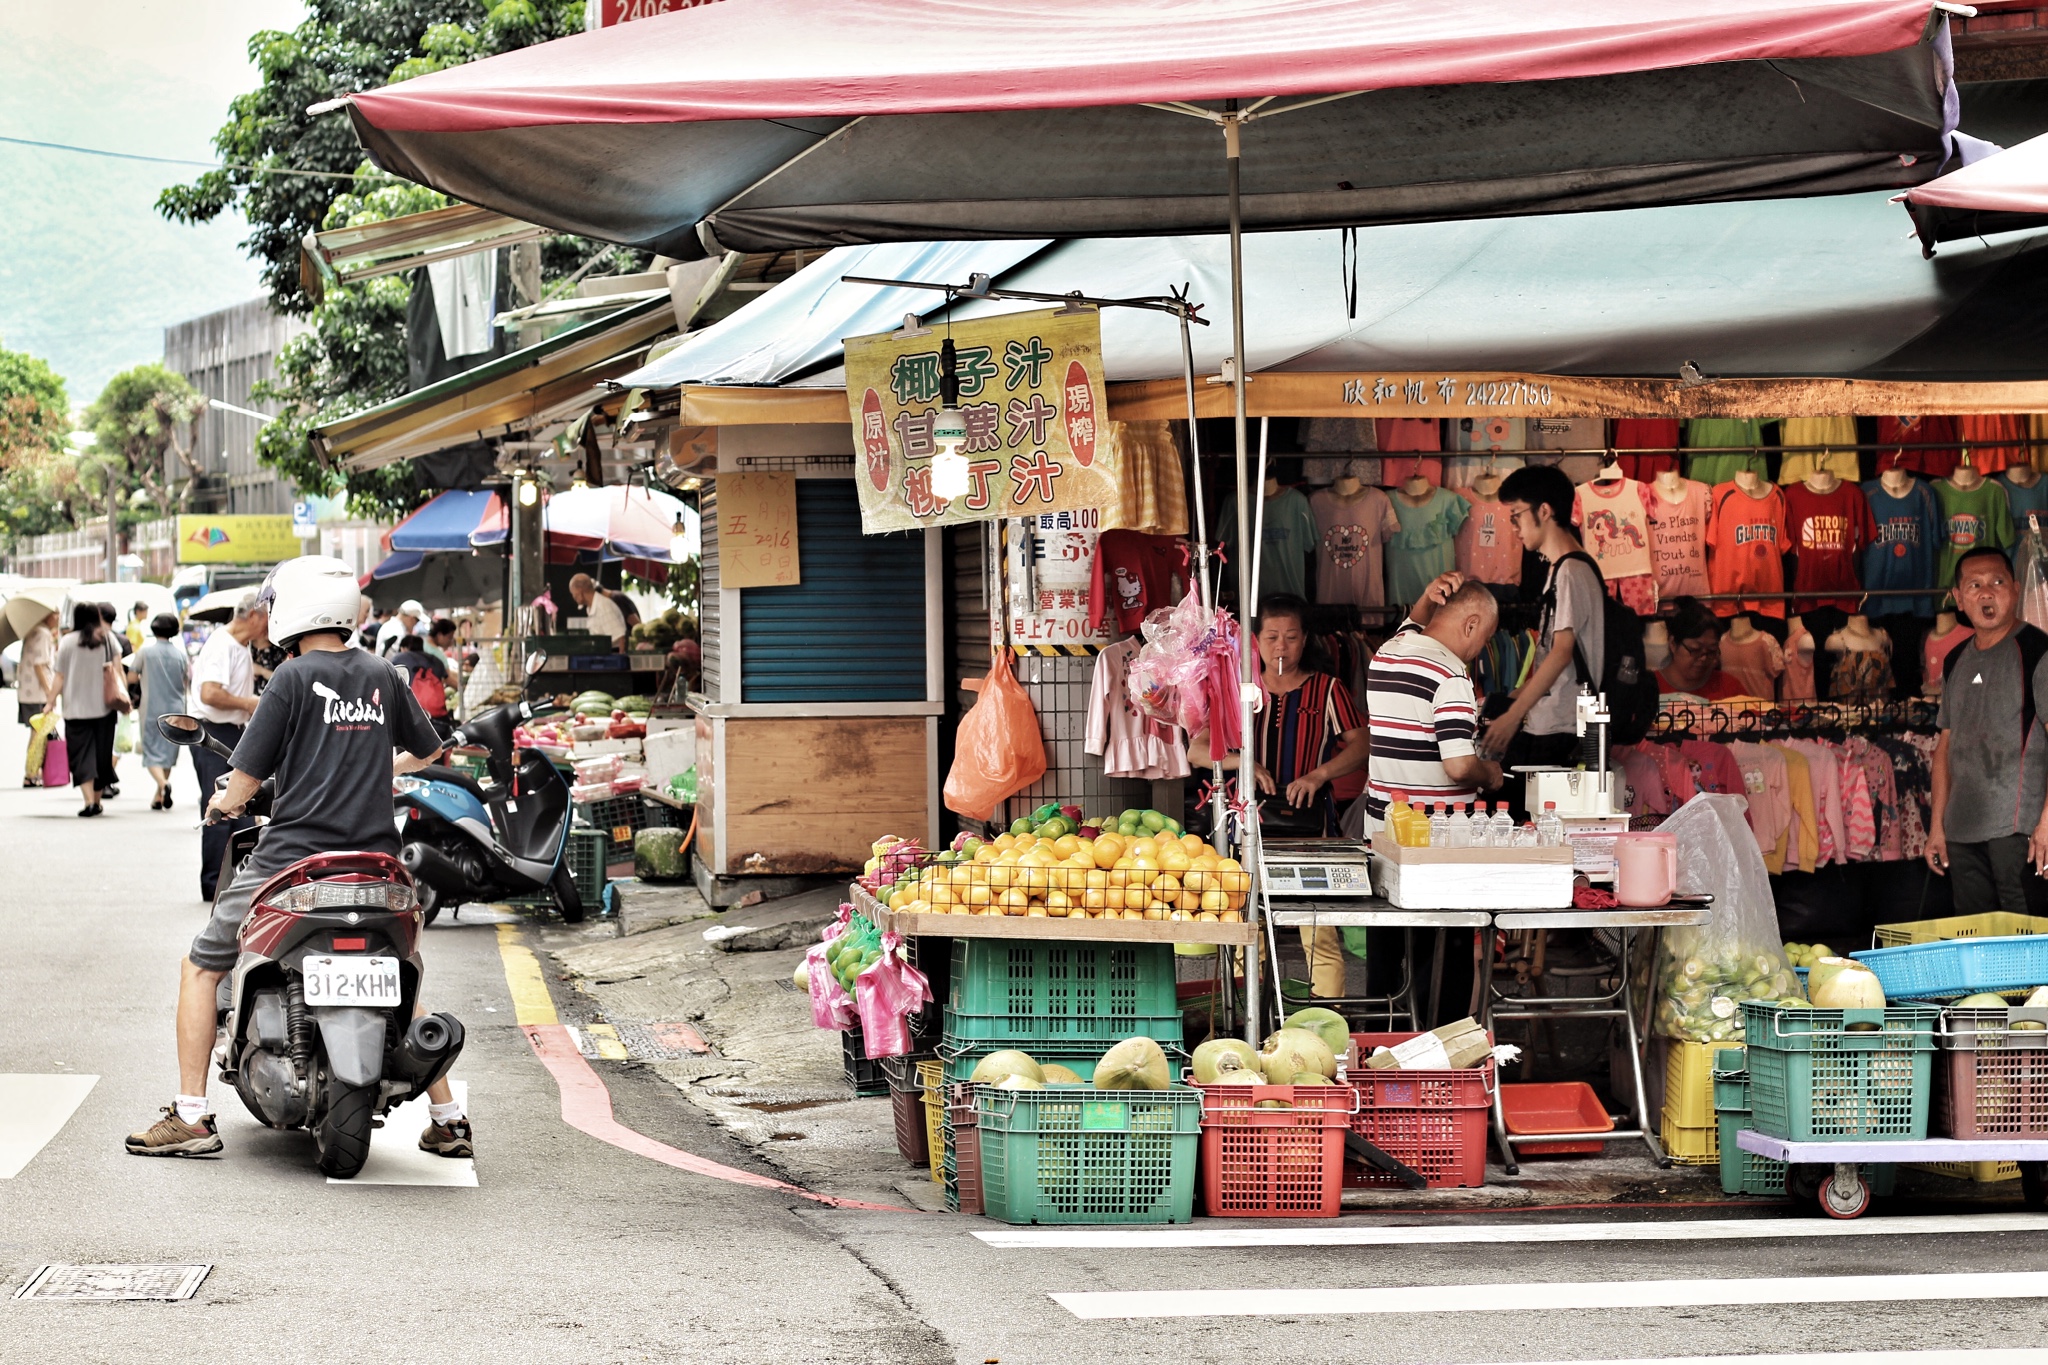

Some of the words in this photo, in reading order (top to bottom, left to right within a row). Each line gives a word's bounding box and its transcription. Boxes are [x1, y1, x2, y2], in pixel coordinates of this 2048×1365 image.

[891, 336, 1053, 404] 椰子汁
[1342, 377, 1458, 405] 欣和帆布
[863, 410, 888, 472] 原汁
[893, 393, 1056, 461] 甘蔗汁
[1066, 384, 1094, 448] 現榨
[904, 451, 1062, 516] 柳丁汁
[308, 974, 398, 998] 312-KHM
